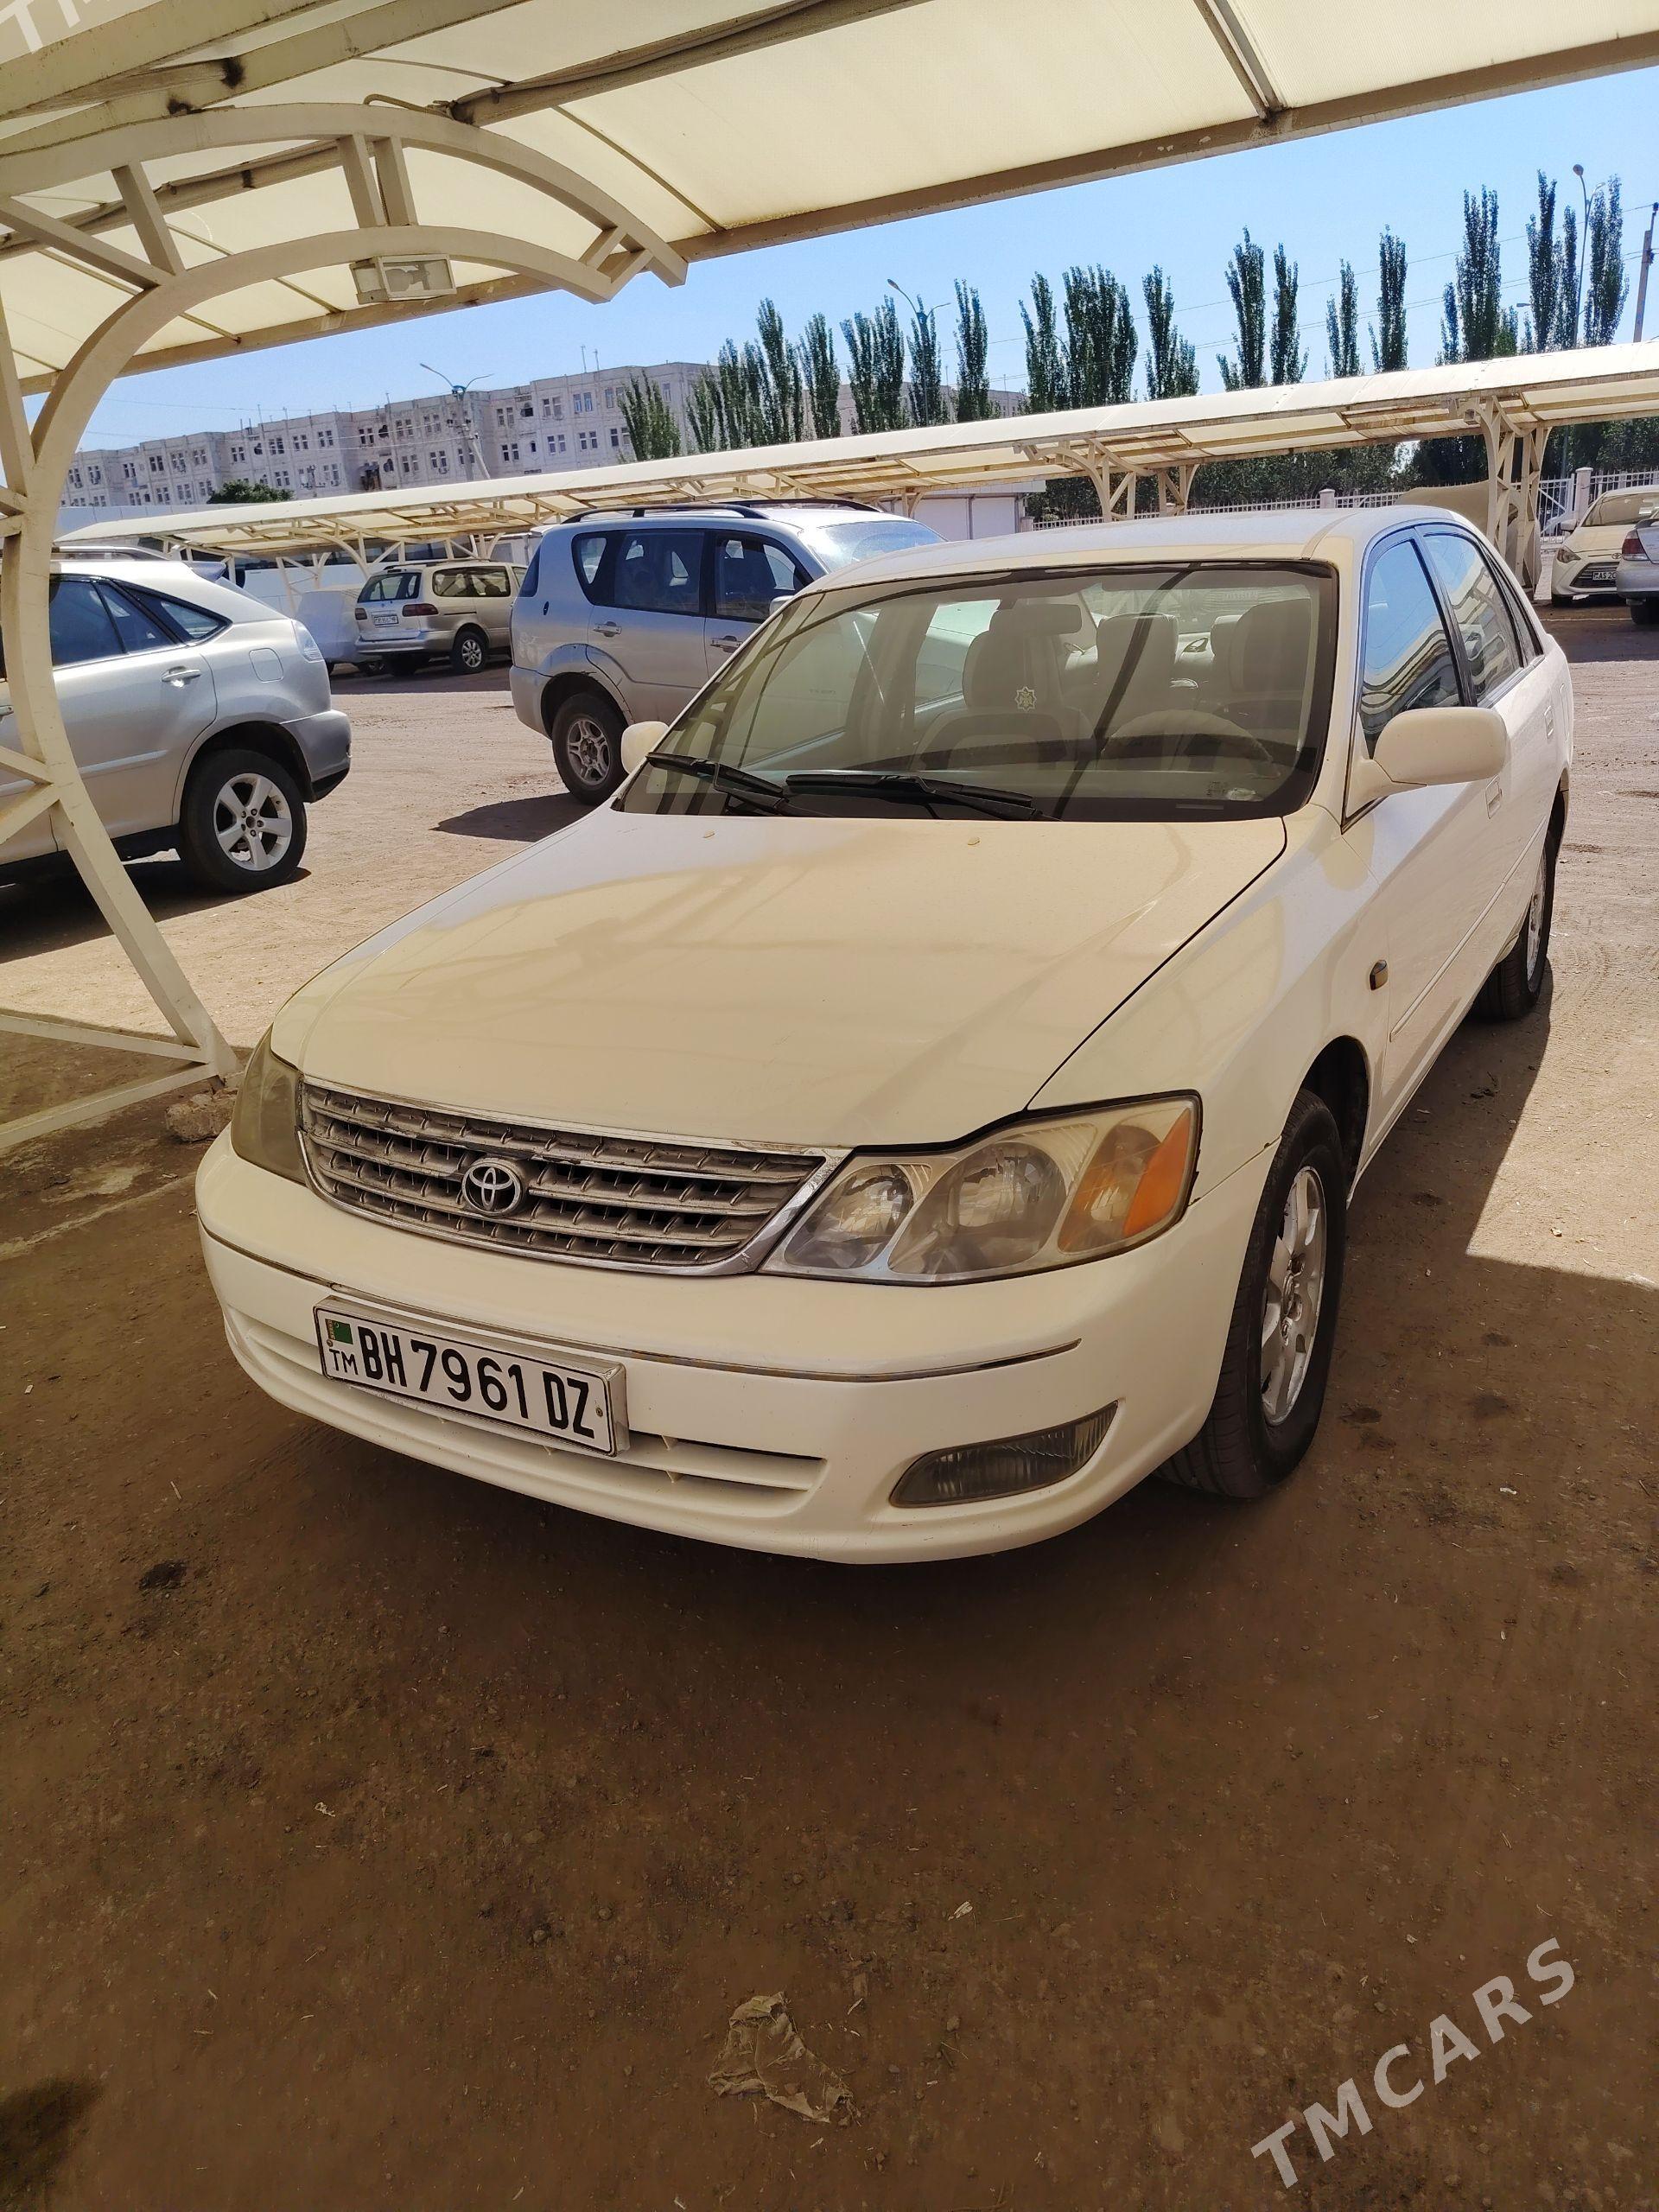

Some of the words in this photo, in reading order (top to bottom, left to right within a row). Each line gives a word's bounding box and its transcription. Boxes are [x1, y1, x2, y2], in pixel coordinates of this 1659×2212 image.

[328, 1348, 359, 1376] TM
[357, 1325, 408, 1388] BH
[410, 1338, 530, 1420] 7961
[542, 1370, 595, 1440] DZ
